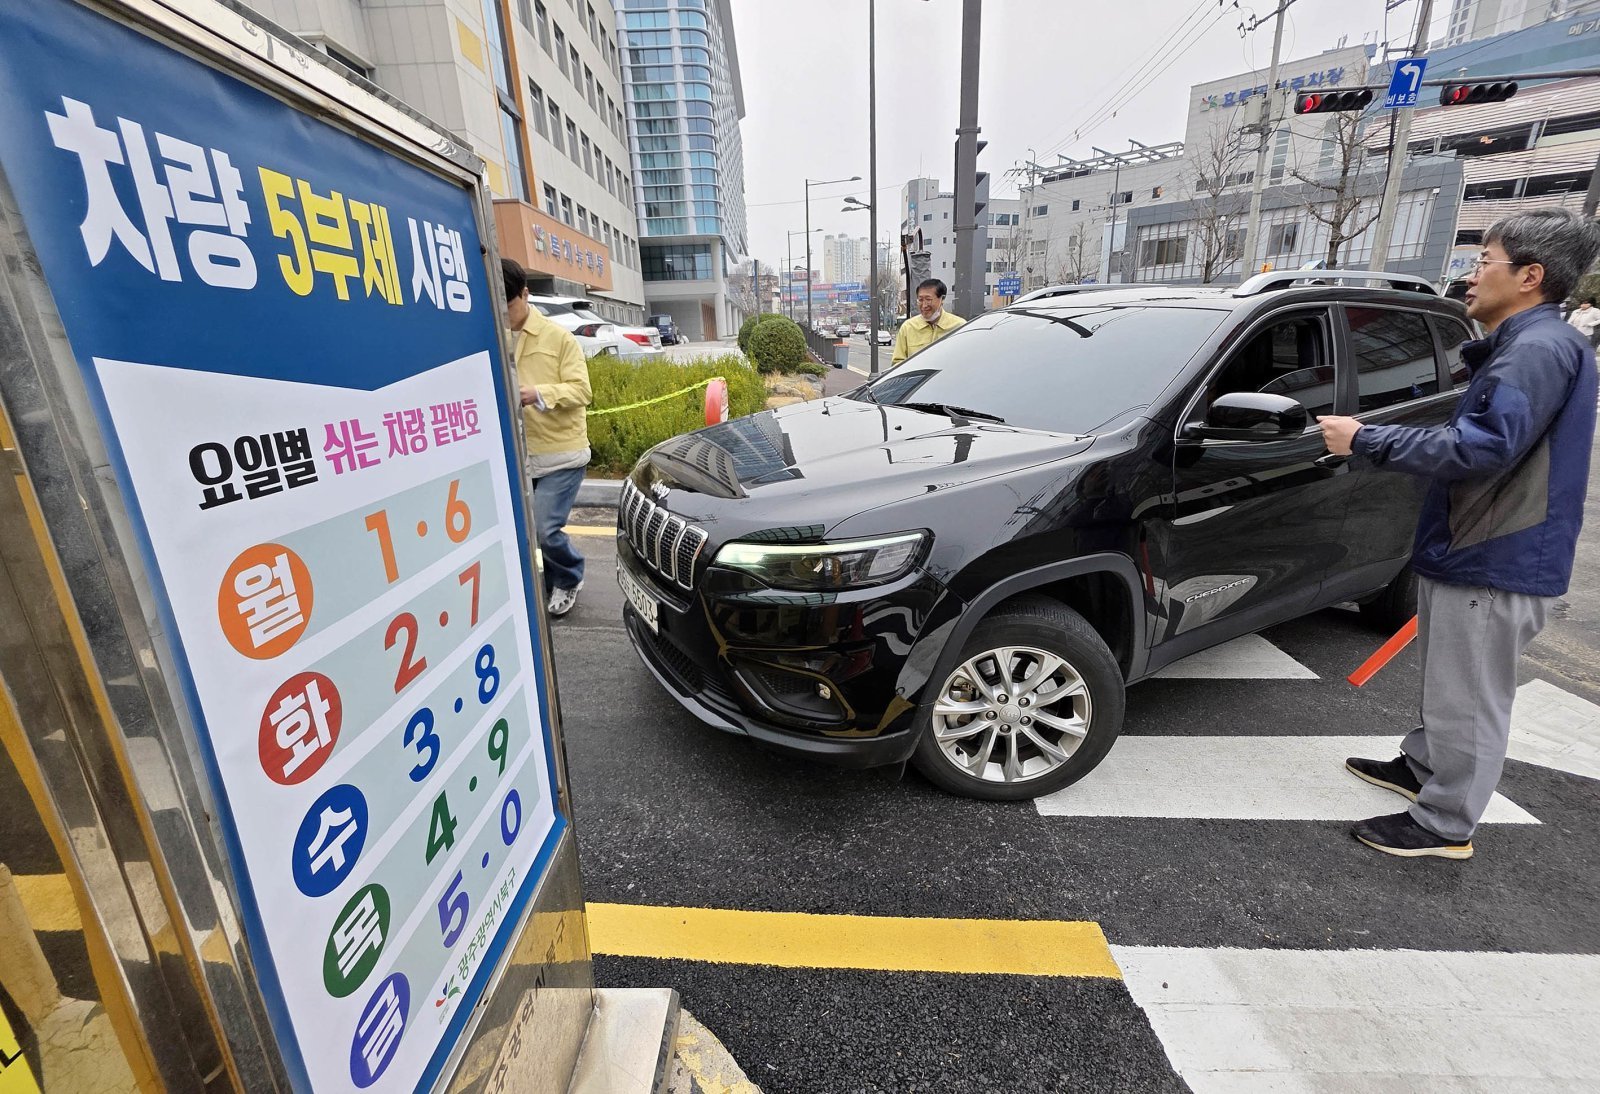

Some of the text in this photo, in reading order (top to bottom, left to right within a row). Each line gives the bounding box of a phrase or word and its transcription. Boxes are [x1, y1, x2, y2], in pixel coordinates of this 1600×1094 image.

[1386, 93, 1416, 105] 비보호
[44, 95, 471, 312] 차량 5부제 시행
[189, 398, 482, 510] 요일별 쉬는 차량 끝번호
[233, 552, 304, 649] 월
[1186, 577, 1250, 602] CHEROKEE
[270, 680, 333, 780] 화
[306, 806, 358, 868] 수
[332, 886, 384, 977] 목
[362, 982, 403, 1072] 금
